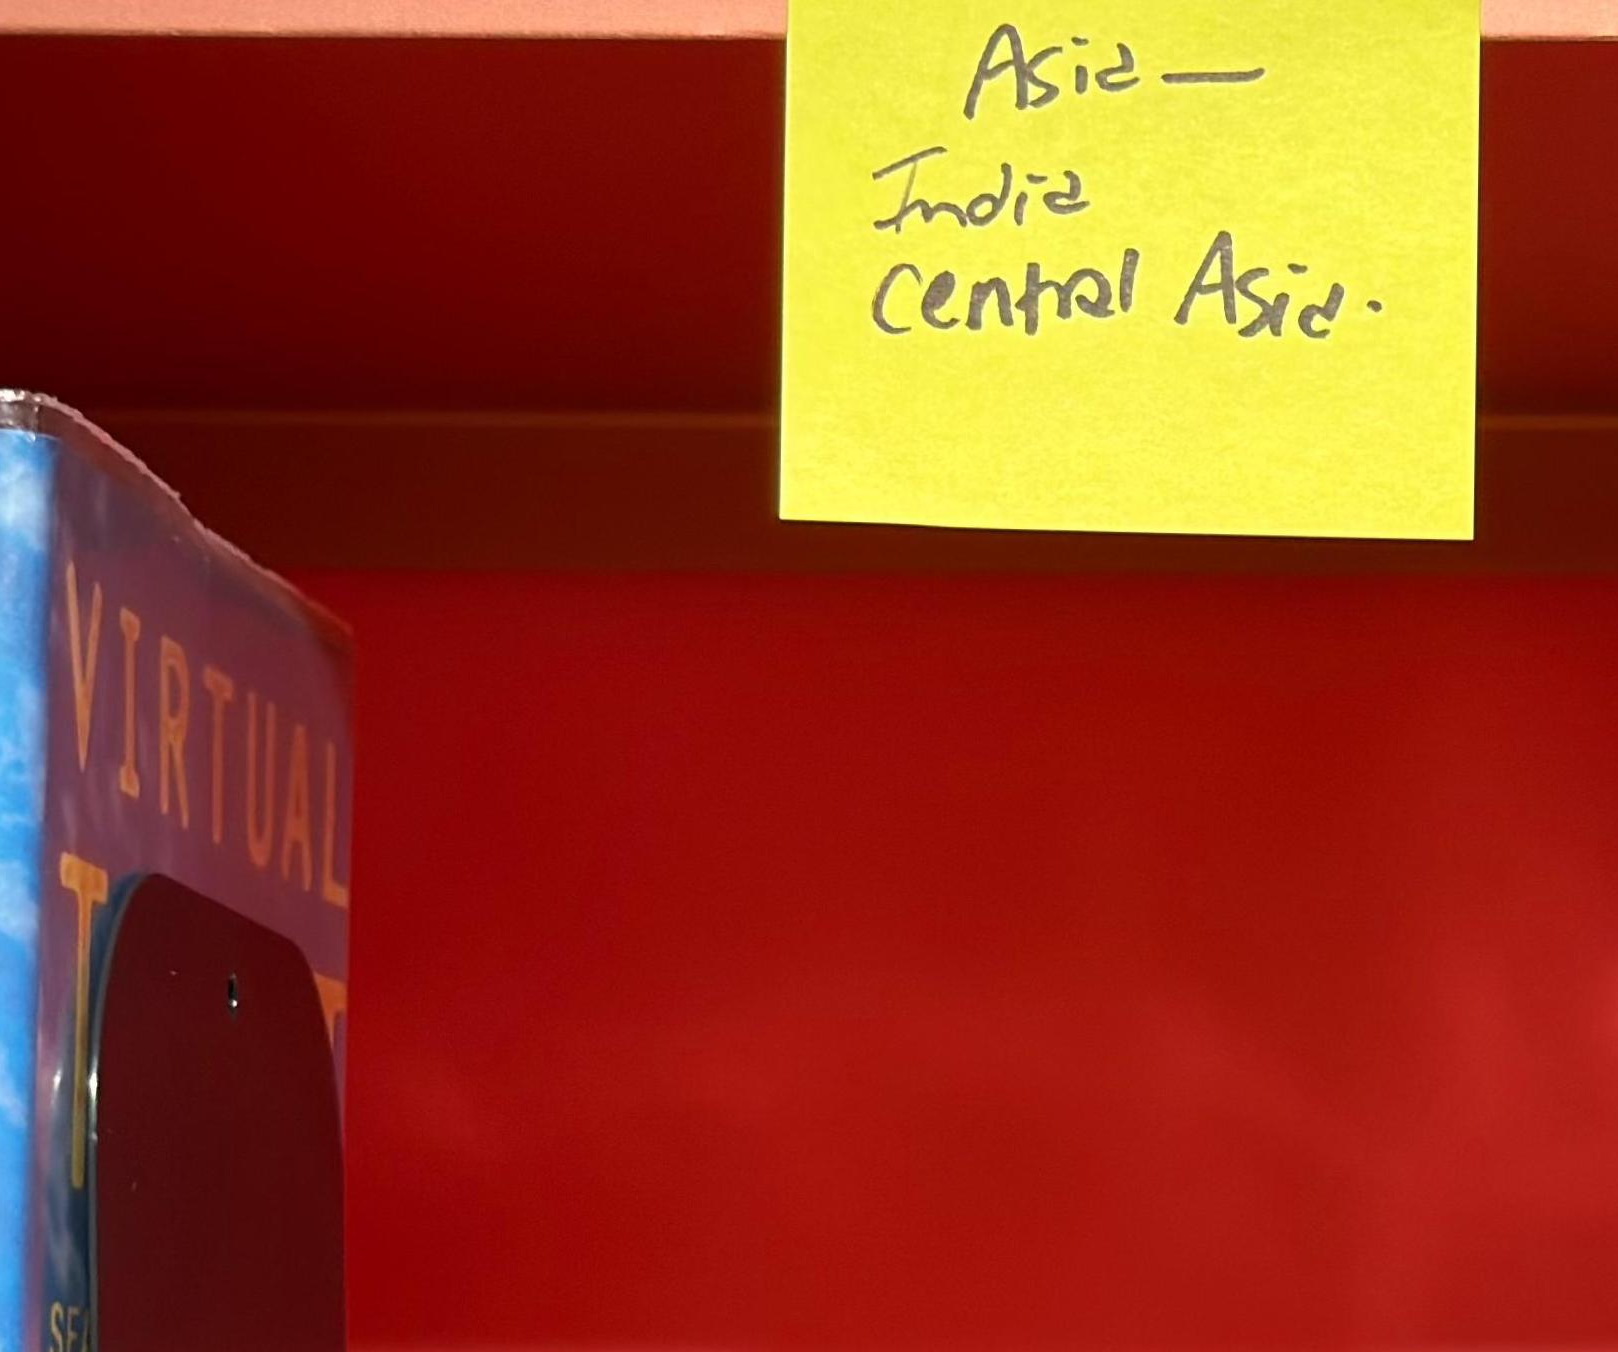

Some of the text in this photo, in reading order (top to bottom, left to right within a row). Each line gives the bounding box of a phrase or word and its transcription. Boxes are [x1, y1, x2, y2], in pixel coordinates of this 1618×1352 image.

[871, 146, 1091, 233] India
[870, 246, 1140, 336] Central
[65, 559, 348, 910] VIRTUAL
